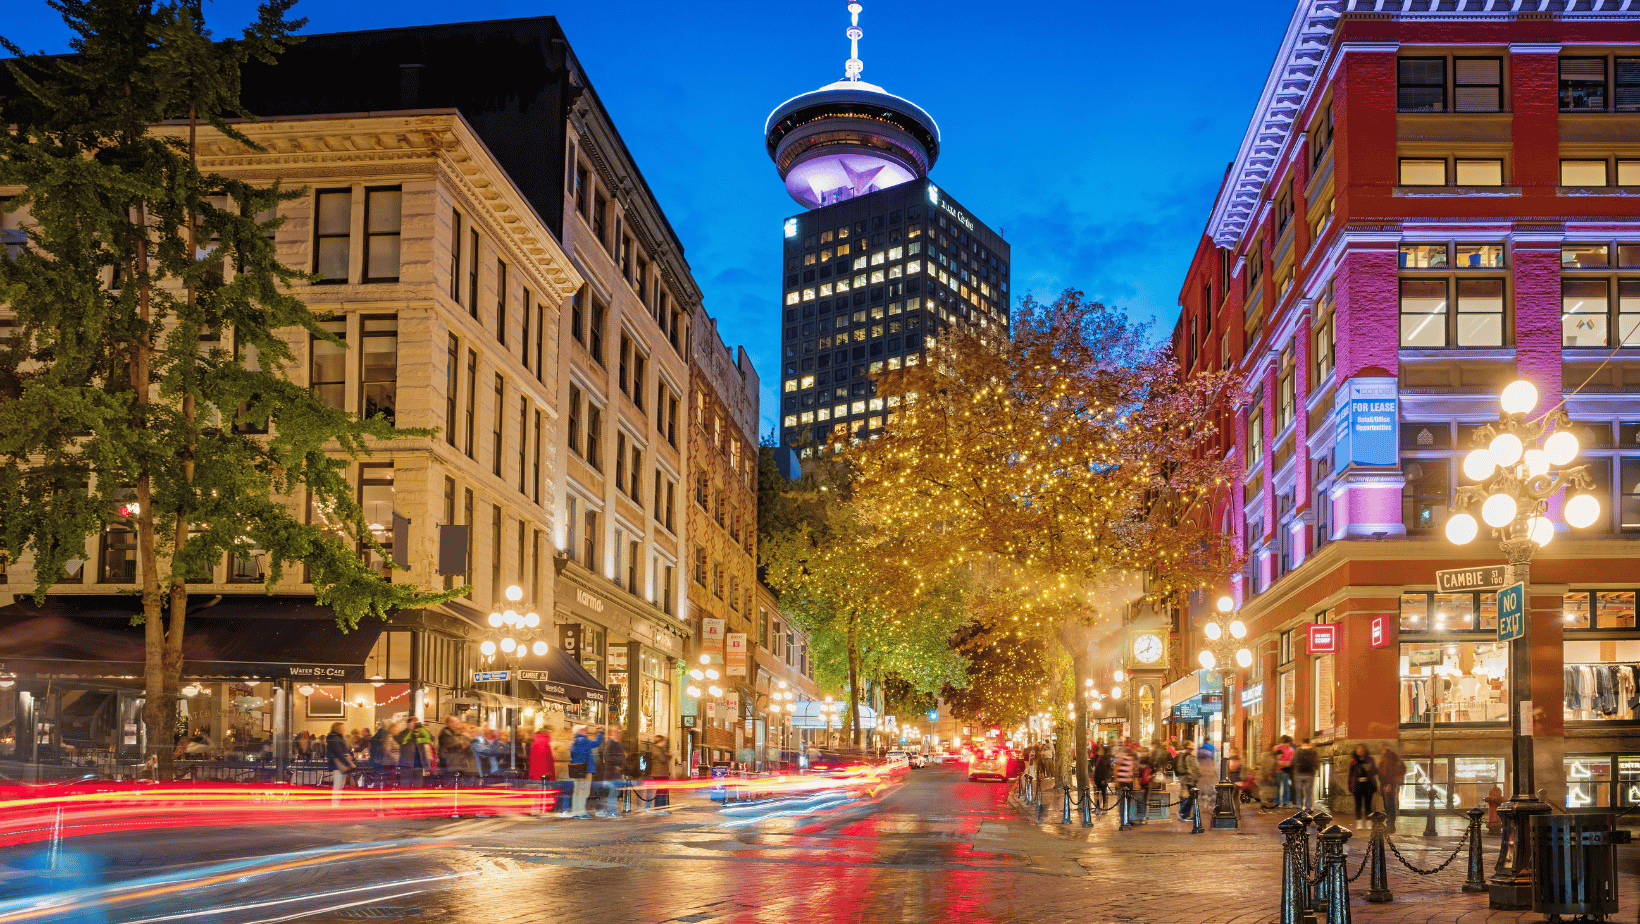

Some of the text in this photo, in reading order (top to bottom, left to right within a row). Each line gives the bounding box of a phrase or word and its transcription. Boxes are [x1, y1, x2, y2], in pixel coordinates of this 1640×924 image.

[1360, 387, 1394, 395] corbel
[1352, 402, 1395, 412] FOR LEASE
[1355, 424, 1392, 432] Opportunities
[1491, 570, 1499, 578] ST
[1443, 571, 1484, 588] CAMBIE
[1491, 577, 1503, 585] 100
[1503, 592, 1517, 613] NO
[1500, 613, 1521, 636] EXIT
[522, 672, 539, 680] CAMBIE
